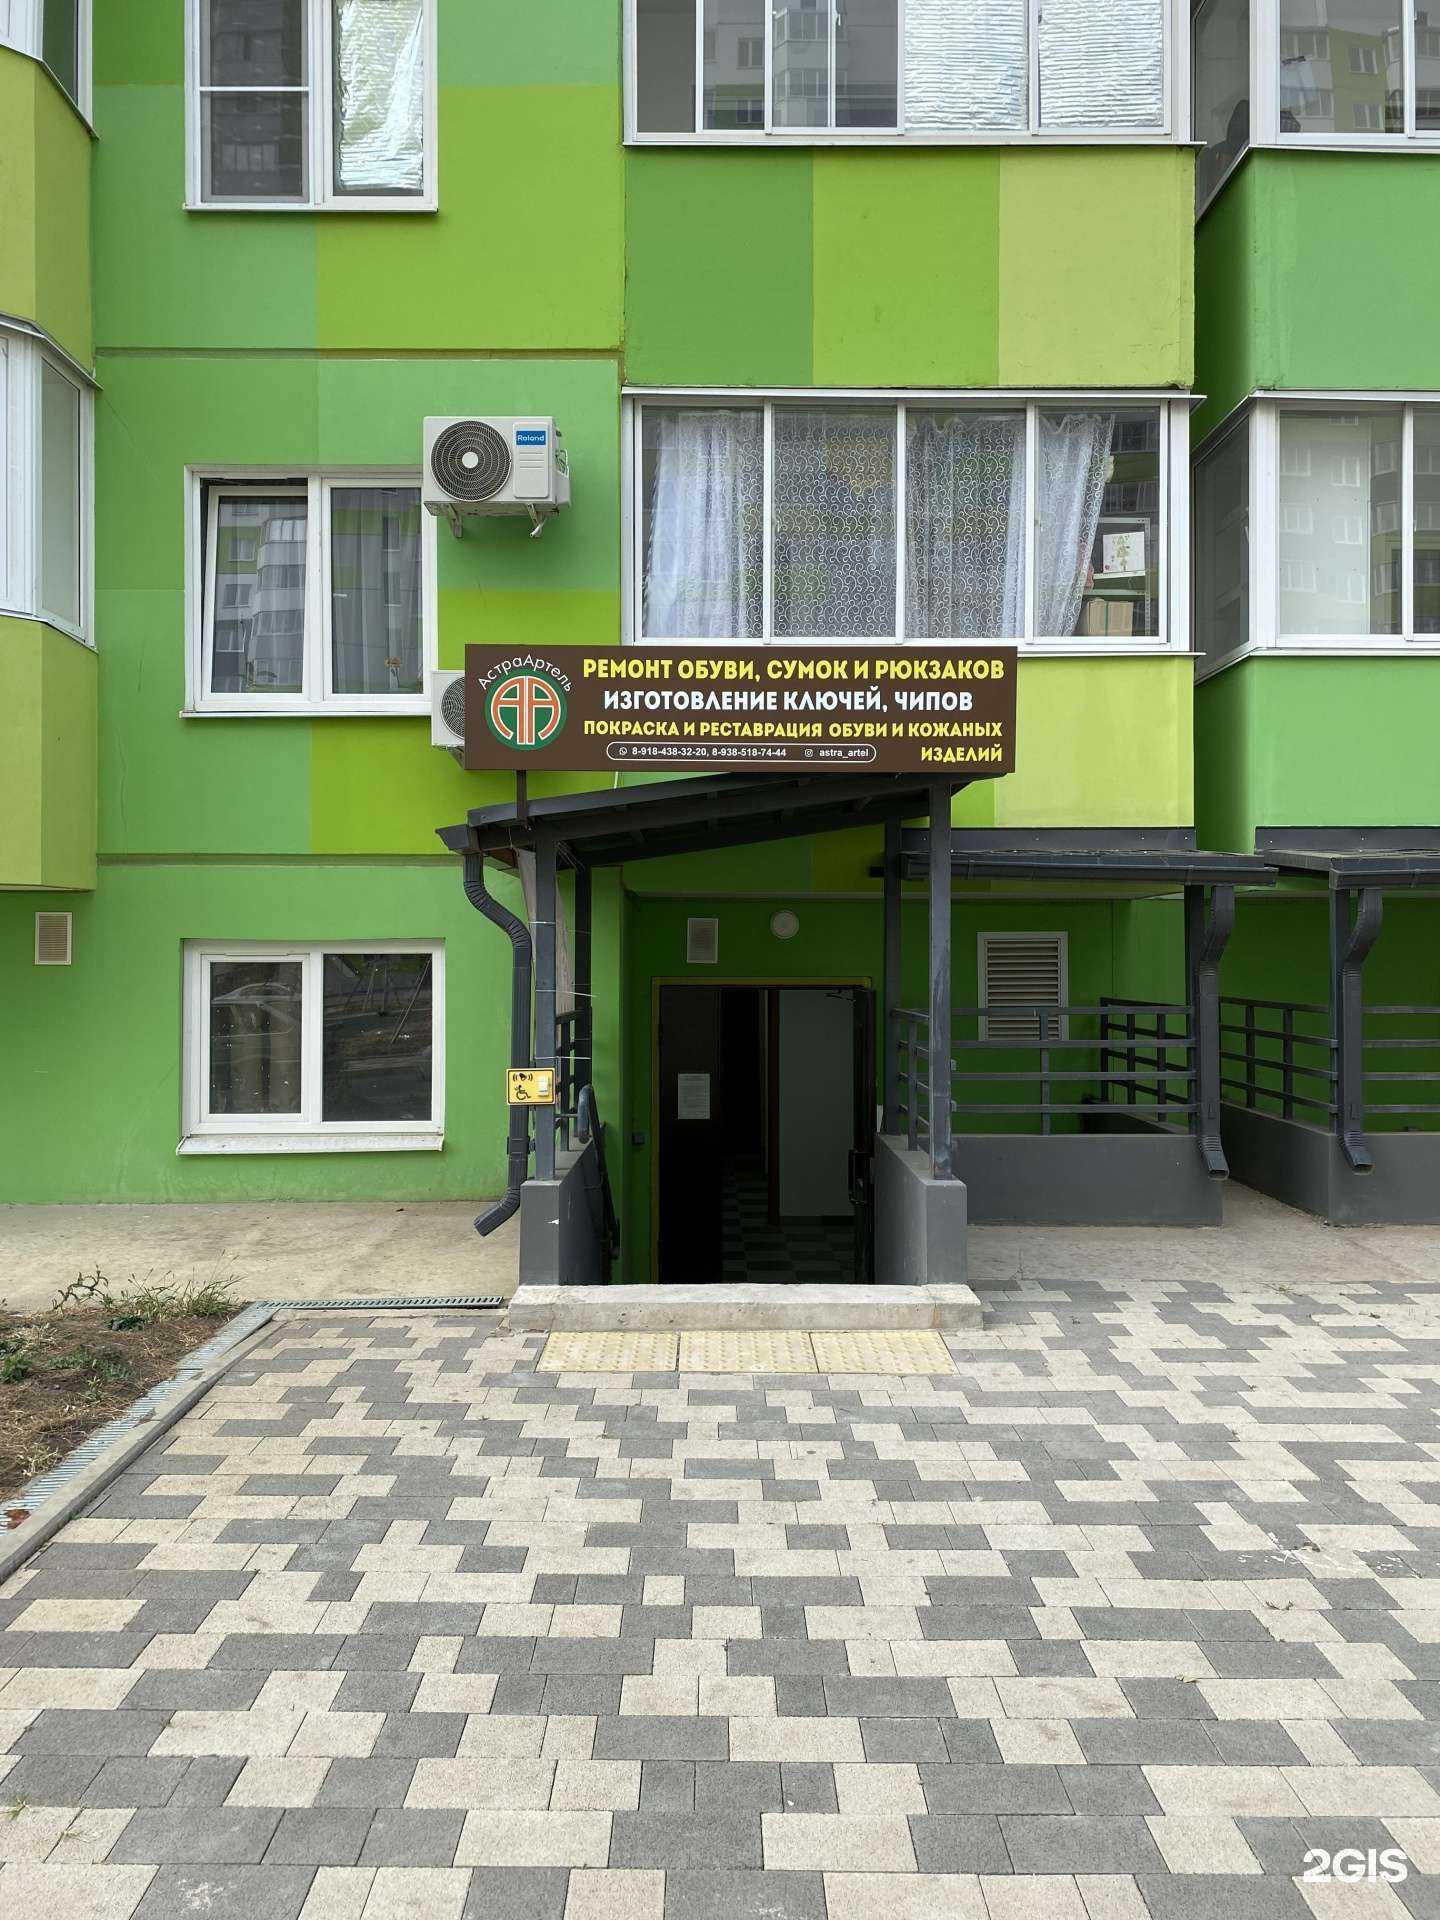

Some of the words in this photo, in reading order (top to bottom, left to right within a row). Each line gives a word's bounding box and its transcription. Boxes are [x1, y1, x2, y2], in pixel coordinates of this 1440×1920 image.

[517, 434, 545, 442] Roland
[479, 654, 573, 693] АстраАртель
[584, 659, 672, 678] РЕМОНТ
[678, 660, 760, 682] ОБУВИ,
[767, 660, 848, 679] СУМОК
[855, 660, 868, 679] И
[876, 660, 1004, 679] РЮКЗАКОВ
[605, 691, 777, 710] ИЗГОТОВЛЕНИЕ
[784, 686, 887, 712] КЛЮЧЕЙ,
[895, 692, 972, 710] ЧИПОВ
[584, 721, 679, 735] ПОКРАСКА
[684, 722, 695, 735] И
[700, 722, 822, 738] РЕСТАВРАЦИЯ
[829, 723, 887, 737] ОБУВИ
[892, 723, 903, 736] И
[909, 723, 1002, 736] КОЖАНЫХ
[632, 747, 709, 758] 8-918-438-32-20,
[712, 748, 787, 757] 8-938-518-74-44
[820, 749, 868, 758] astra_artel
[922, 744, 1002, 762] ИЗДЕЛИЙ
